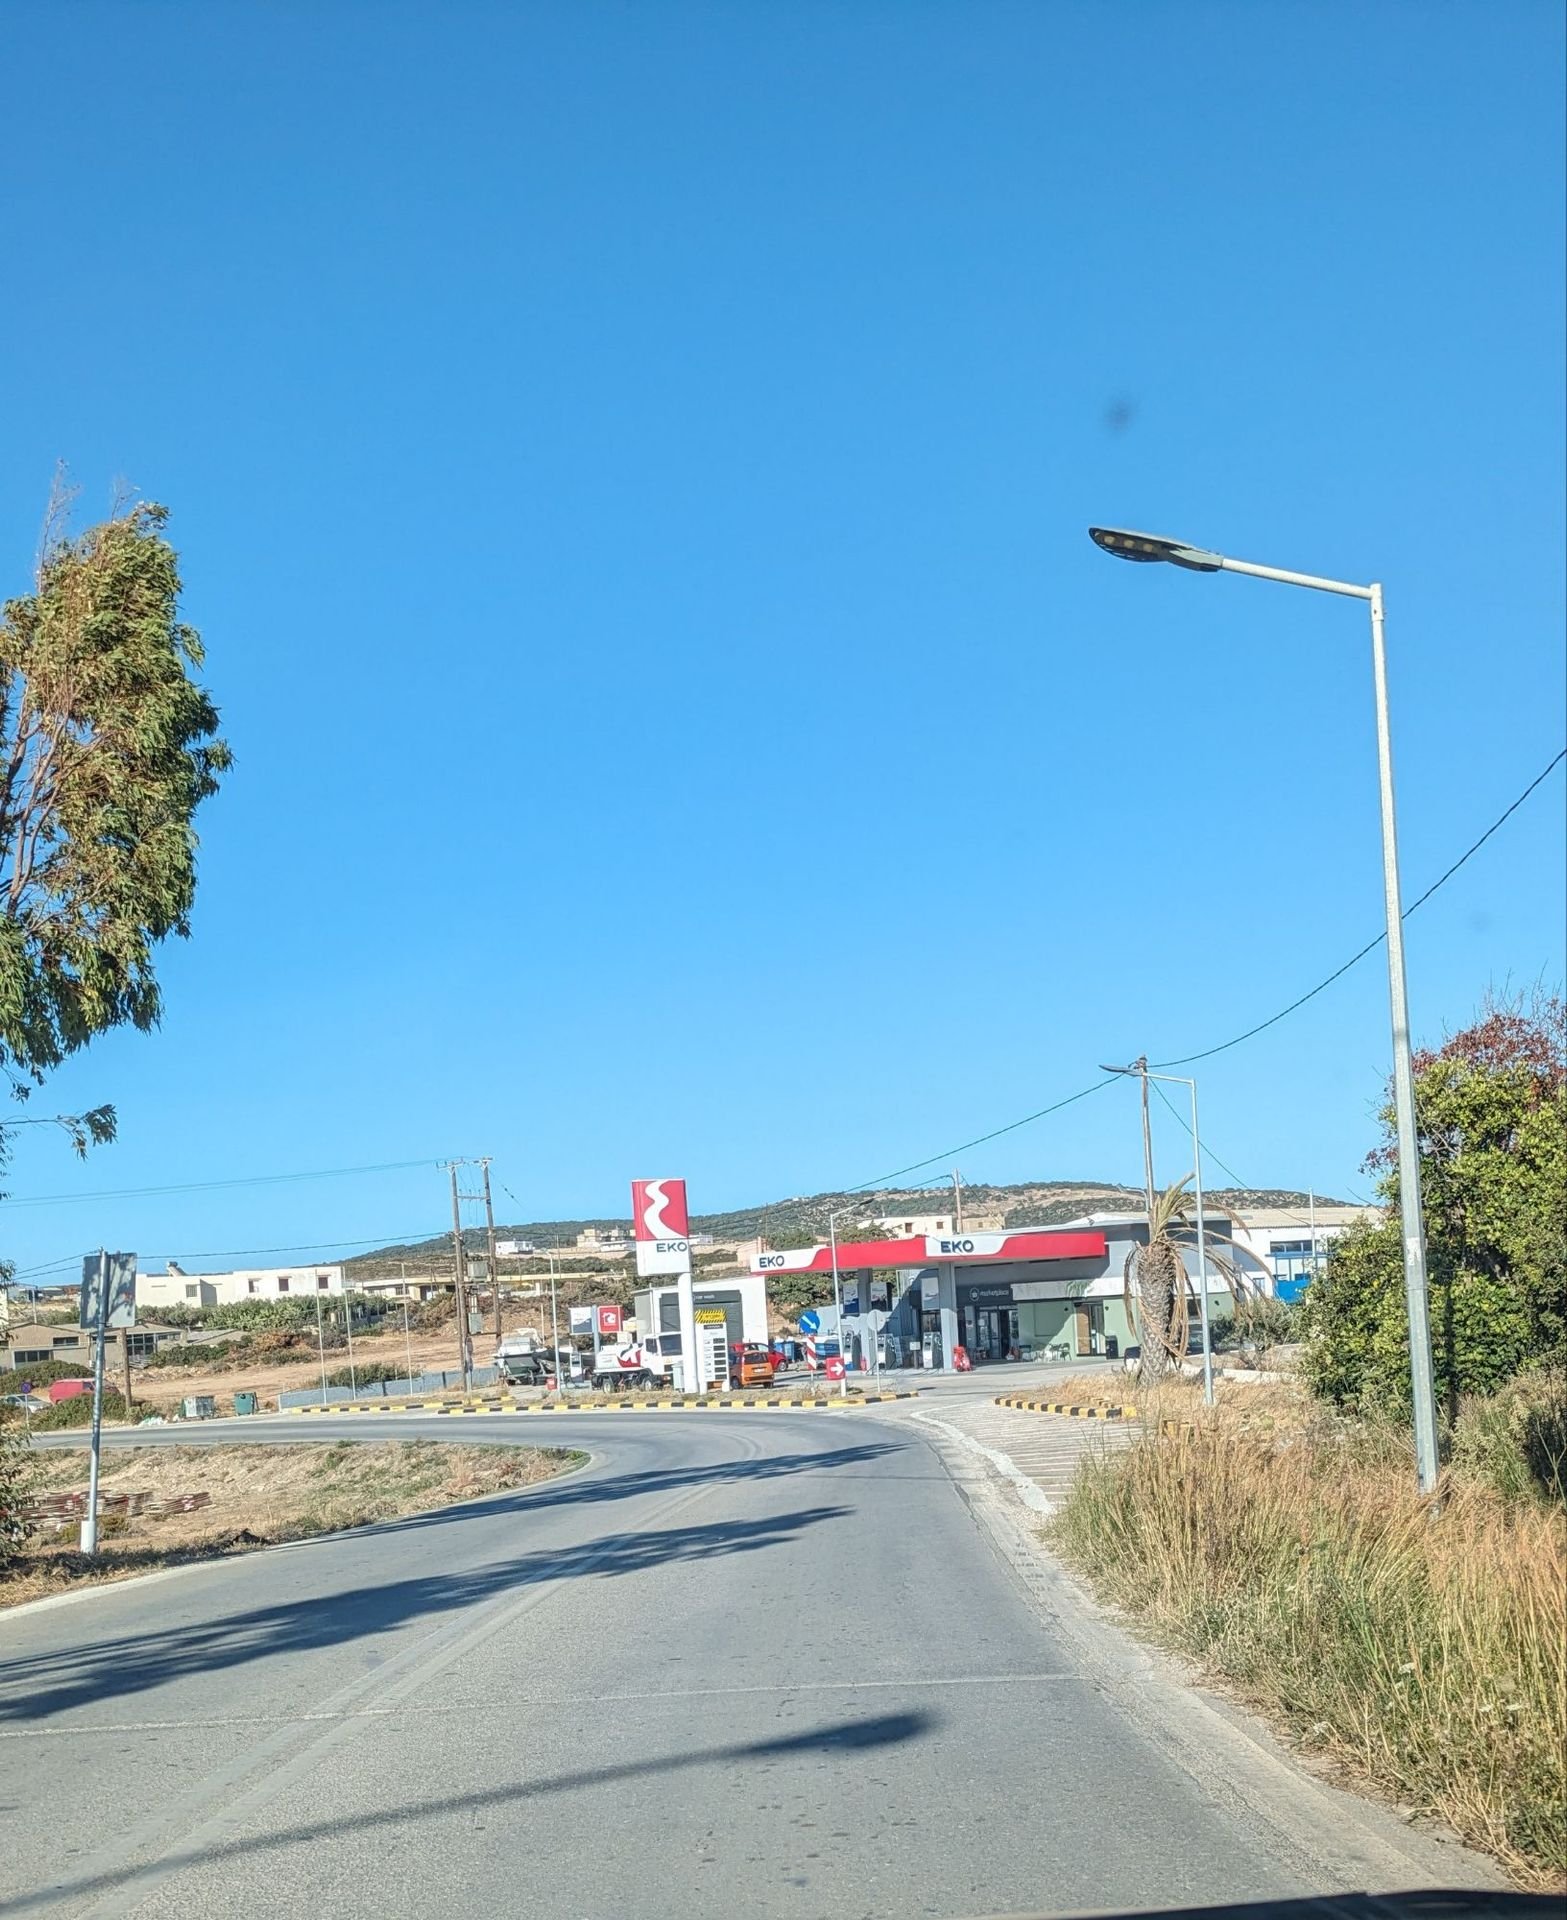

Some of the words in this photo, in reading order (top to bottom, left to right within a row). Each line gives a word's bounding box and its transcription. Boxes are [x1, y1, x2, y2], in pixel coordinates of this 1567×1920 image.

[656, 1242, 688, 1252] EKO
[940, 1240, 974, 1253] EKO
[759, 1255, 784, 1268] EKO
